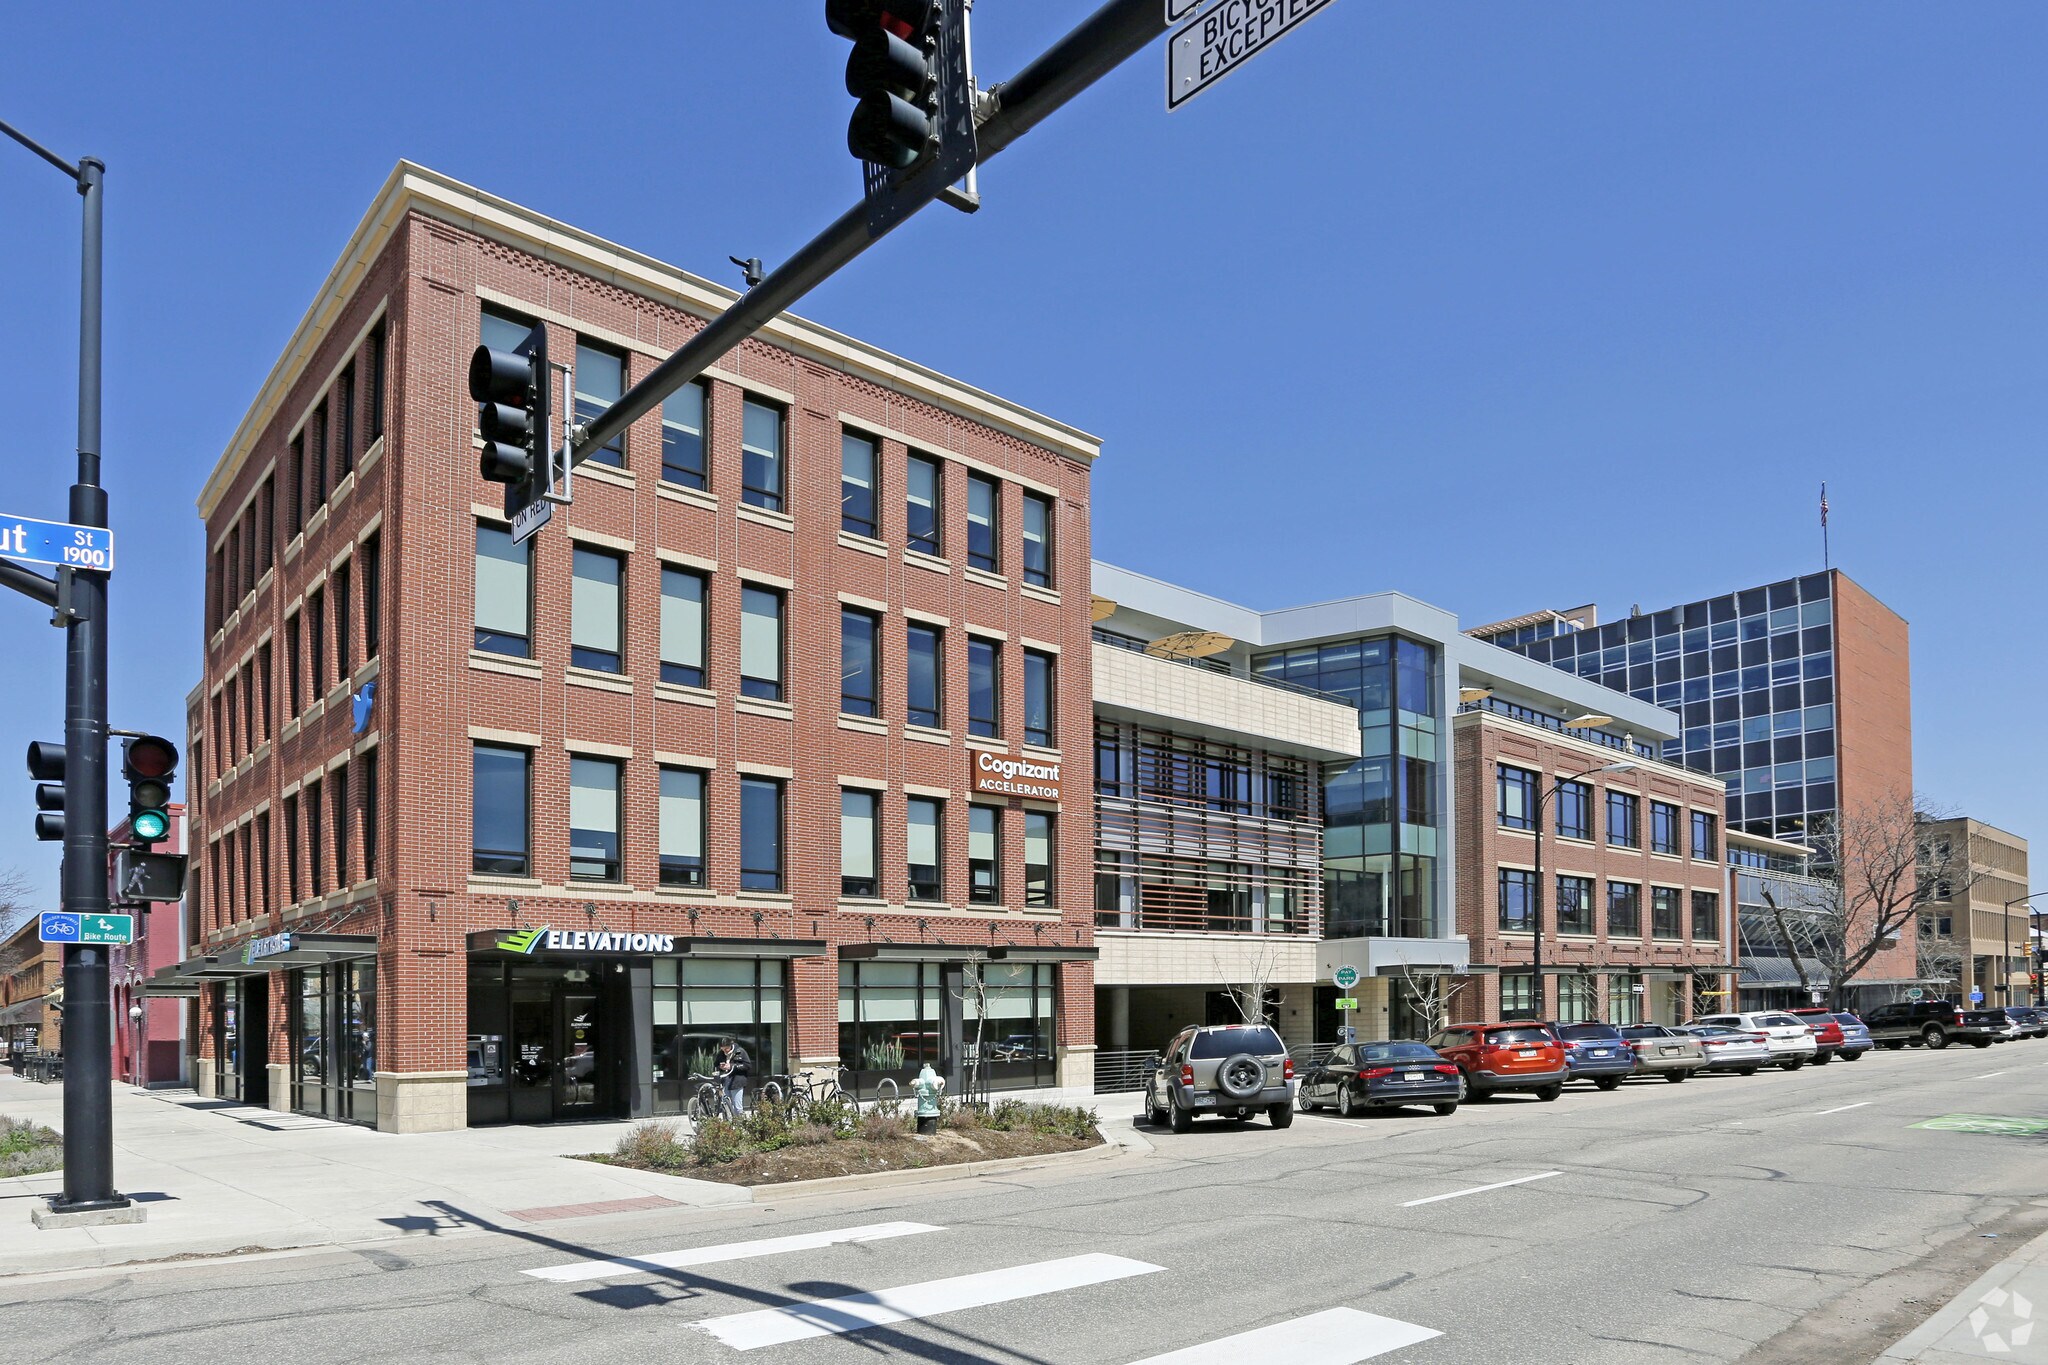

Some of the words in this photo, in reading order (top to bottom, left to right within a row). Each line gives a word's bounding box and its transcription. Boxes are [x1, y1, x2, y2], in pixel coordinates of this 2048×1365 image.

[1200, 0, 1316, 81] EXCEPTE
[516, 508, 527, 528] ON
[530, 500, 547, 518] RED
[74, 530, 94, 547] St
[63, 546, 105, 566] 1900
[979, 752, 1060, 781] Cognizant
[979, 778, 1059, 799] ACCELERATOR
[84, 932, 101, 941] Bike
[104, 933, 127, 941] Route
[546, 931, 674, 952] ELEVATIONS
